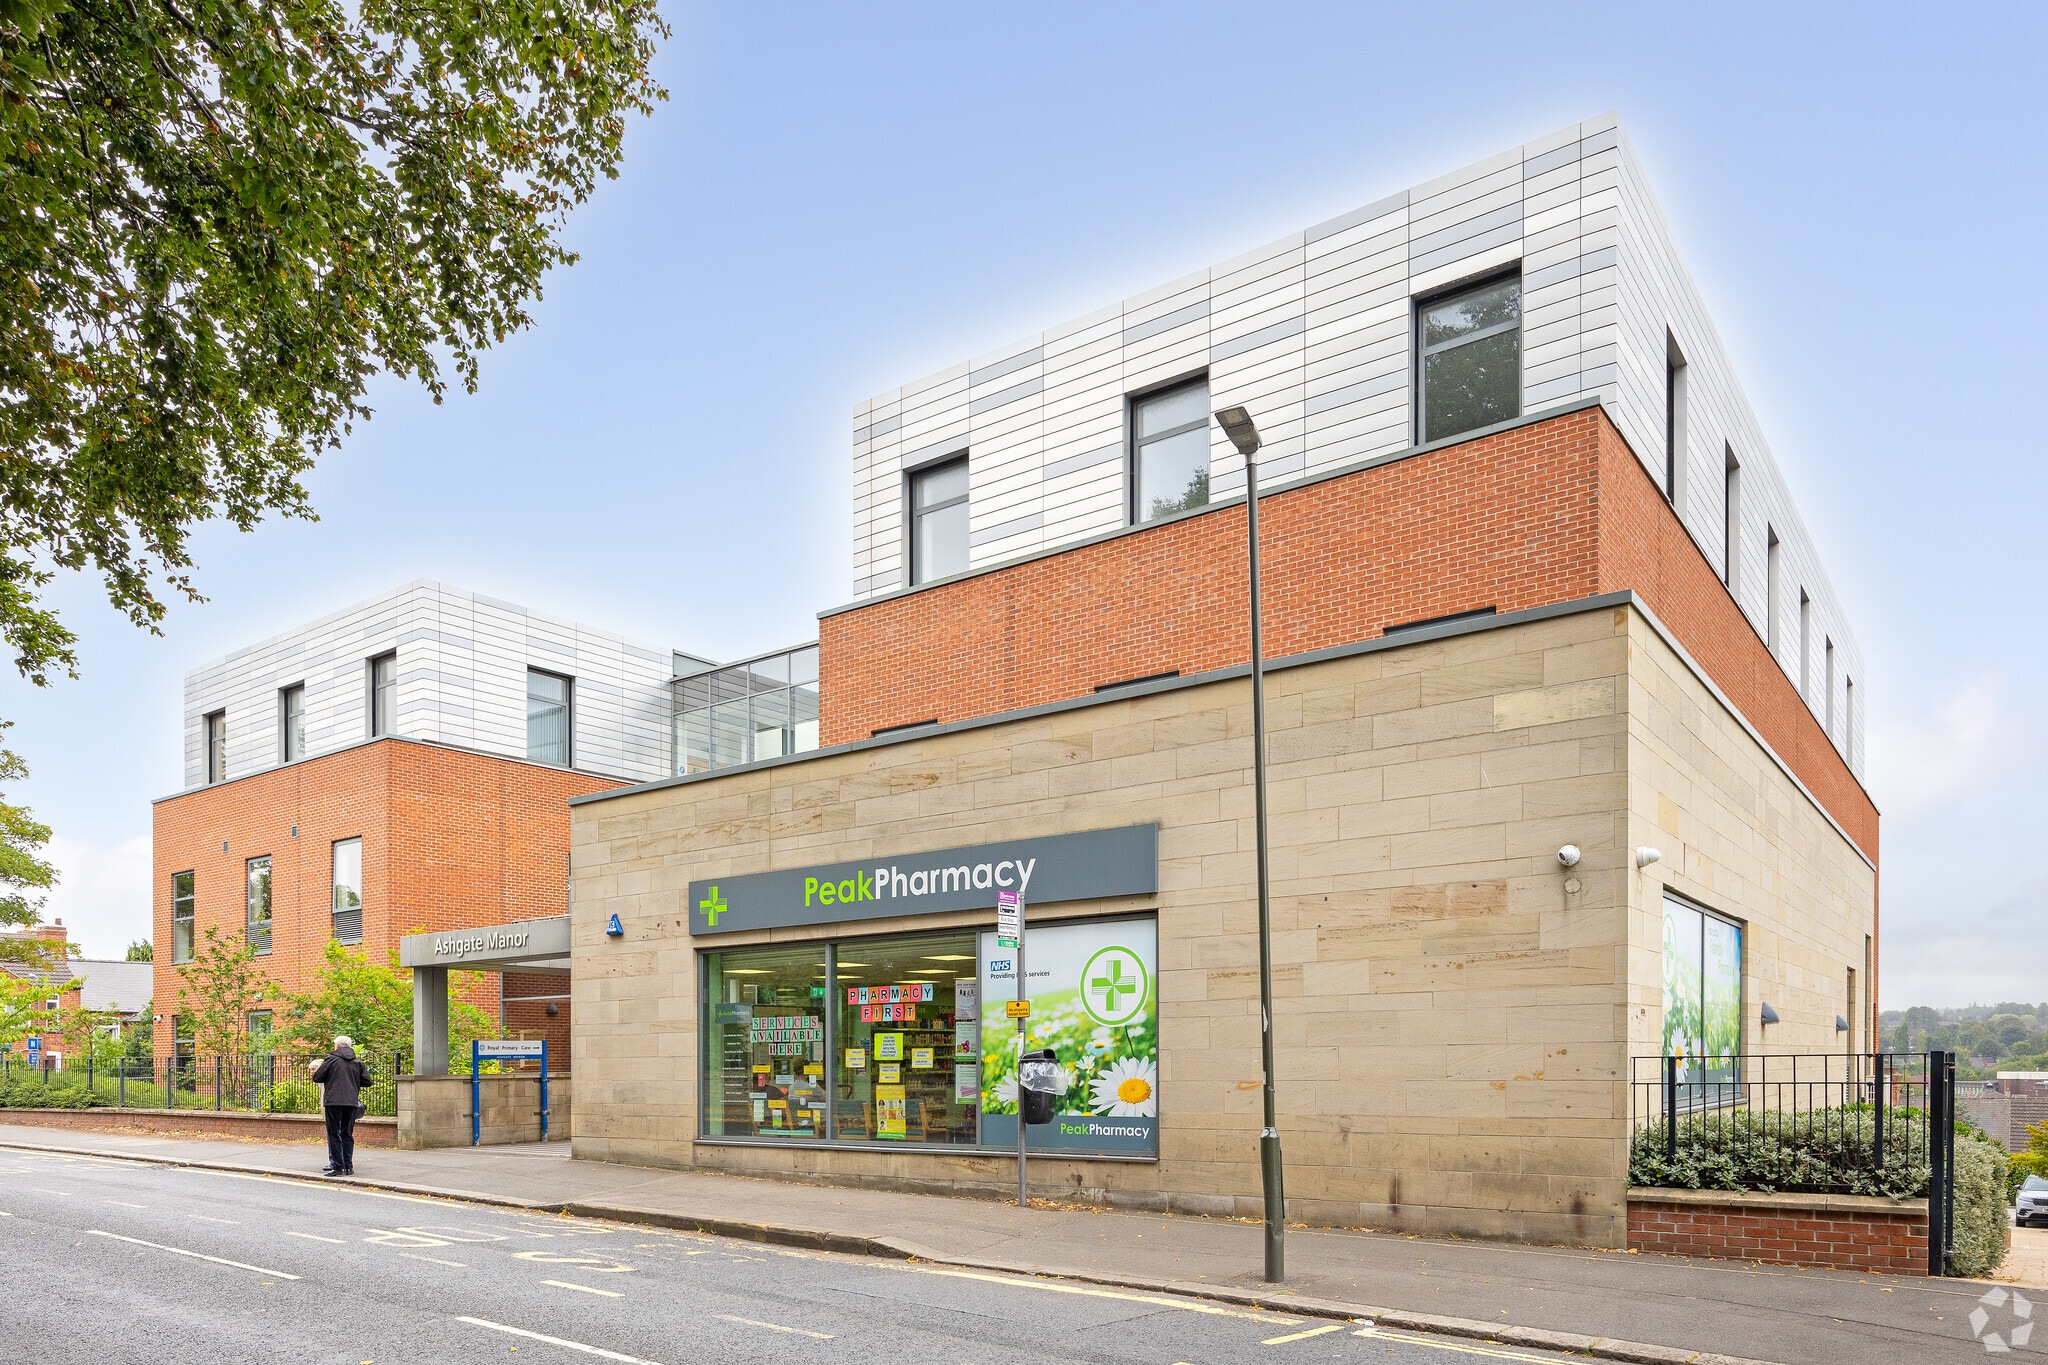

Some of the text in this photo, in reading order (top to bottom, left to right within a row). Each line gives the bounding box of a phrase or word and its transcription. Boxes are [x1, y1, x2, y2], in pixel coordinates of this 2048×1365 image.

[805, 858, 1036, 907] PeakPharmacy
[434, 932, 529, 957] Ashgate Manor
[991, 960, 1010, 971] NHS
[850, 987, 931, 1001] PHARMACY
[864, 1007, 913, 1018] FIRST
[753, 1017, 817, 1029] SERVICES
[751, 1030, 821, 1041] AVAILABLE
[769, 1044, 802, 1054] HERE
[1060, 1123, 1150, 1139] PeakPharmacy
